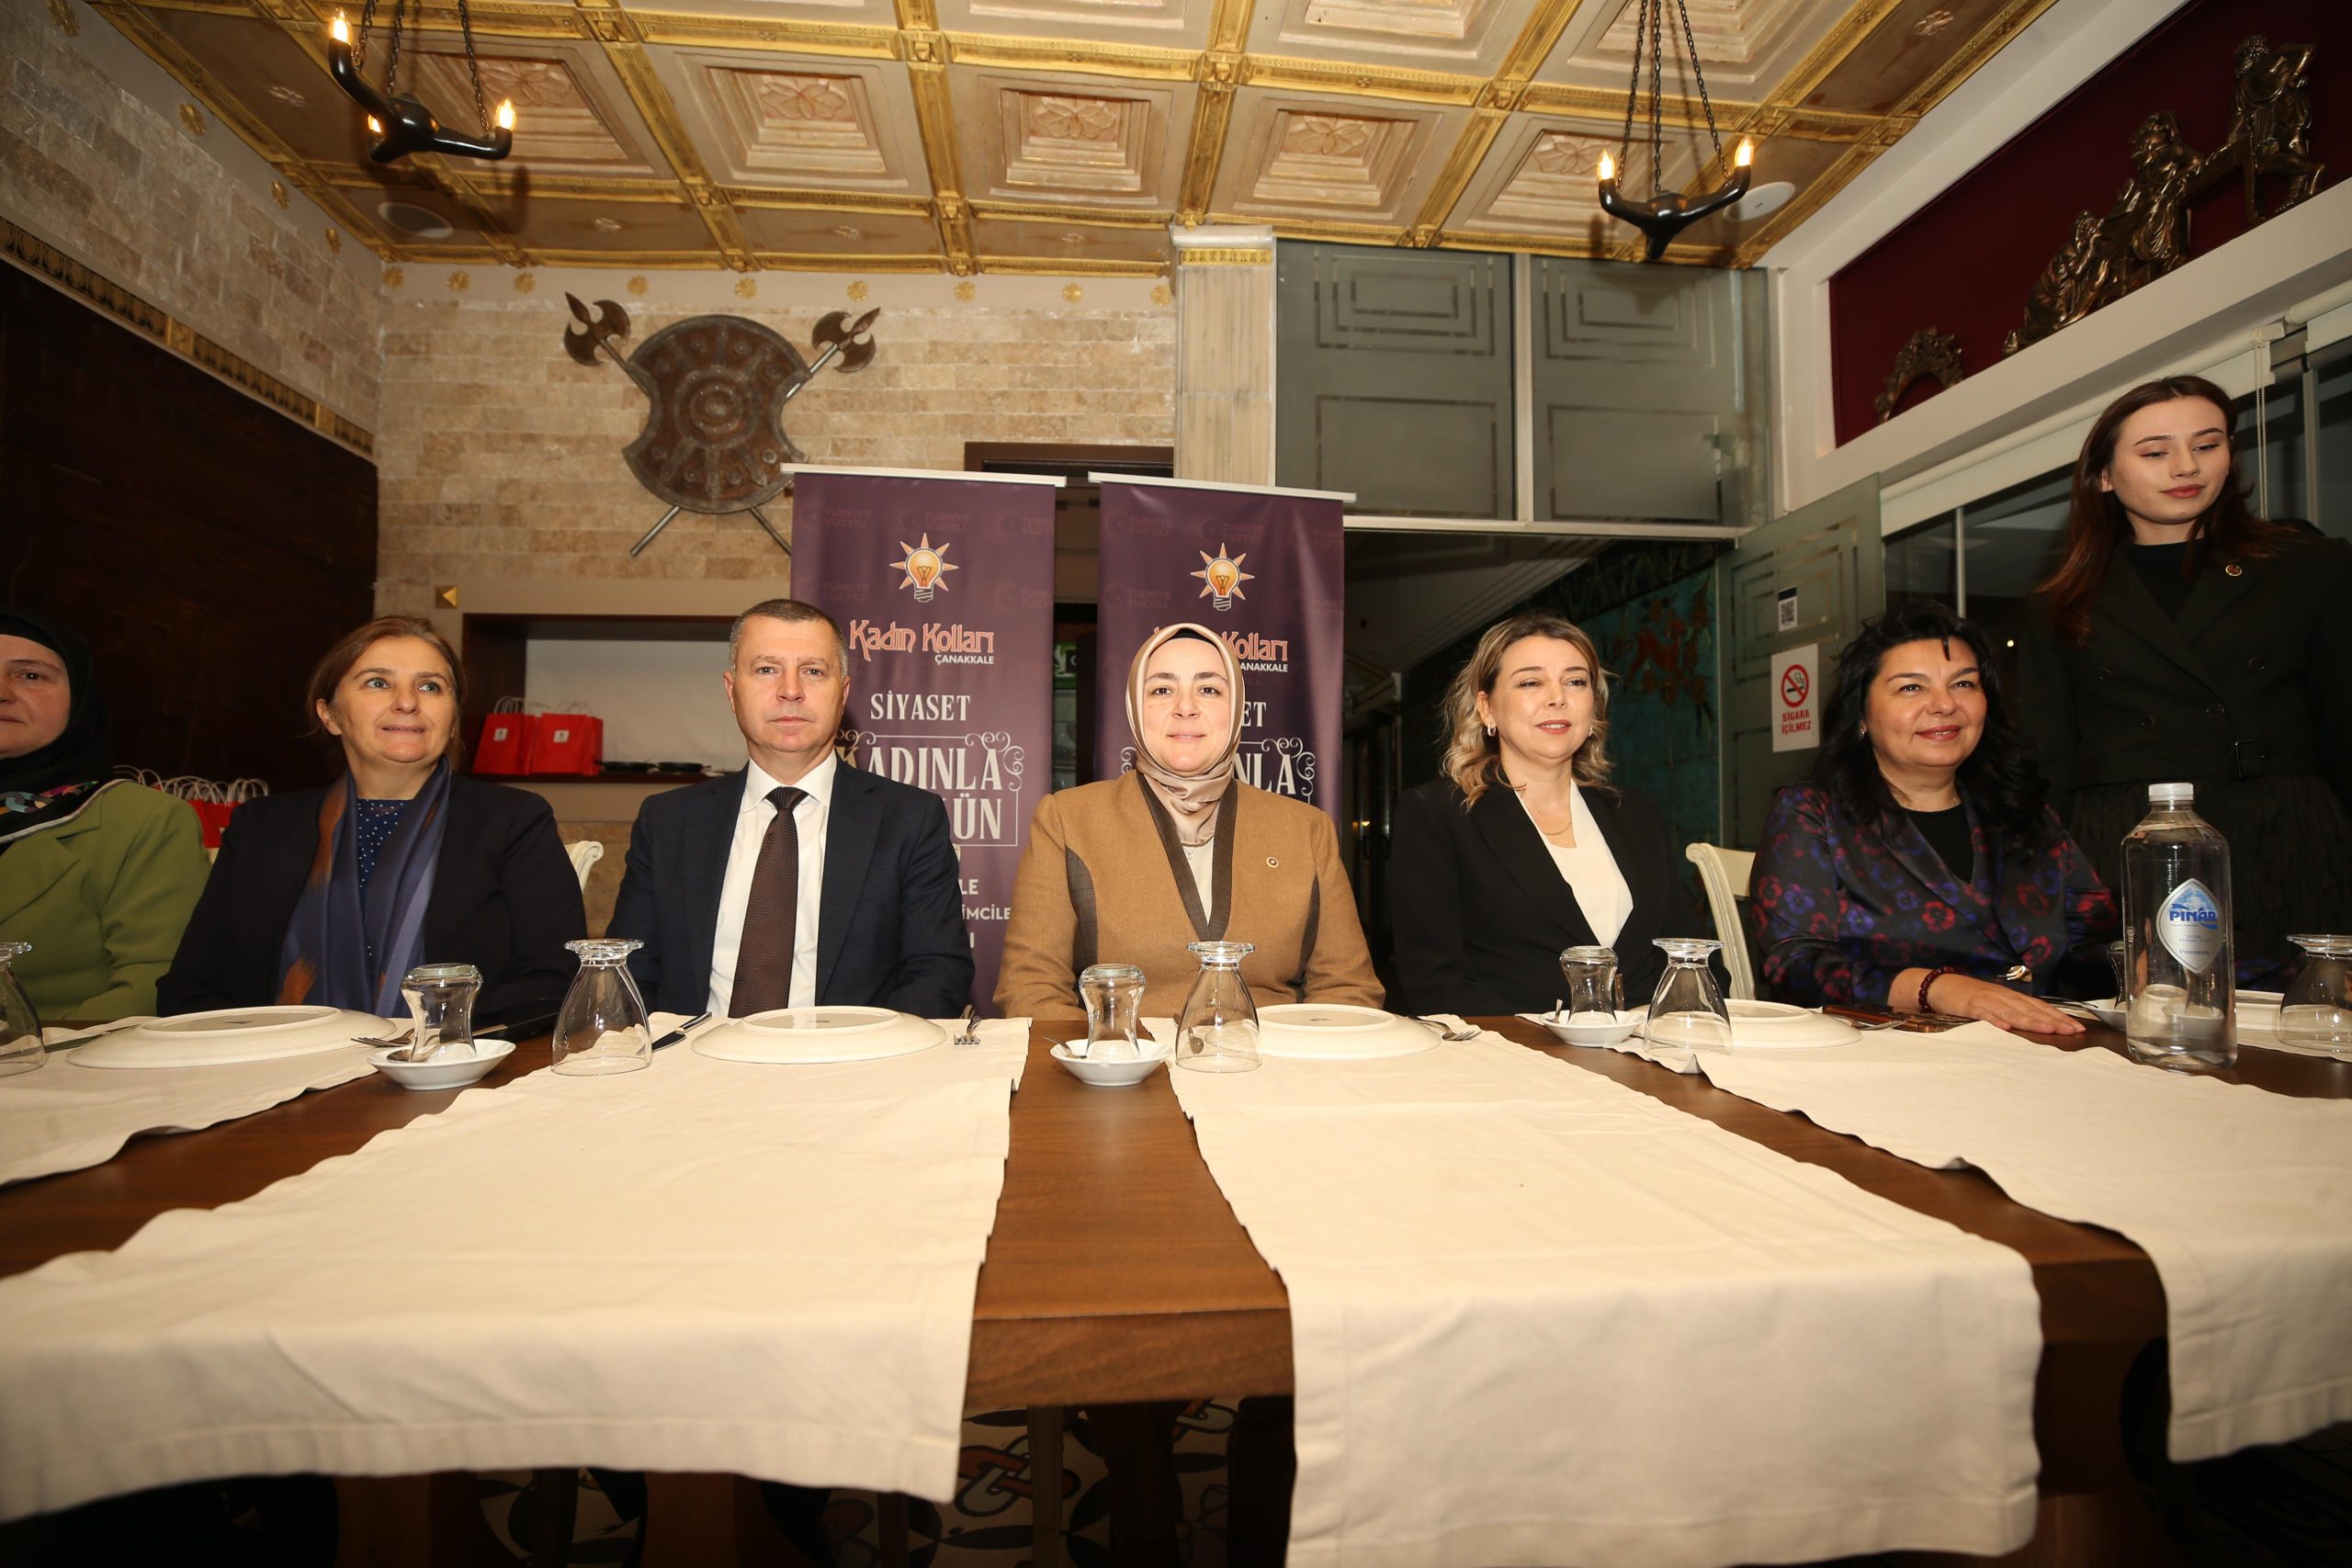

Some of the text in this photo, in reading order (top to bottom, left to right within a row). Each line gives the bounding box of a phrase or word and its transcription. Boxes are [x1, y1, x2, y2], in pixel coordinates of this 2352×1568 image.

[849, 619, 995, 661] Kadın Kolları
[934, 654, 995, 665] ÇANAKKALE
[1240, 662, 1288, 672] ANAKKALE
[870, 690, 970, 721] SİYASET
[1782, 709, 1810, 722] SİGARA
[1781, 720, 1812, 736] İÇİLMEZ
[2169, 908, 2217, 922] PINAR
